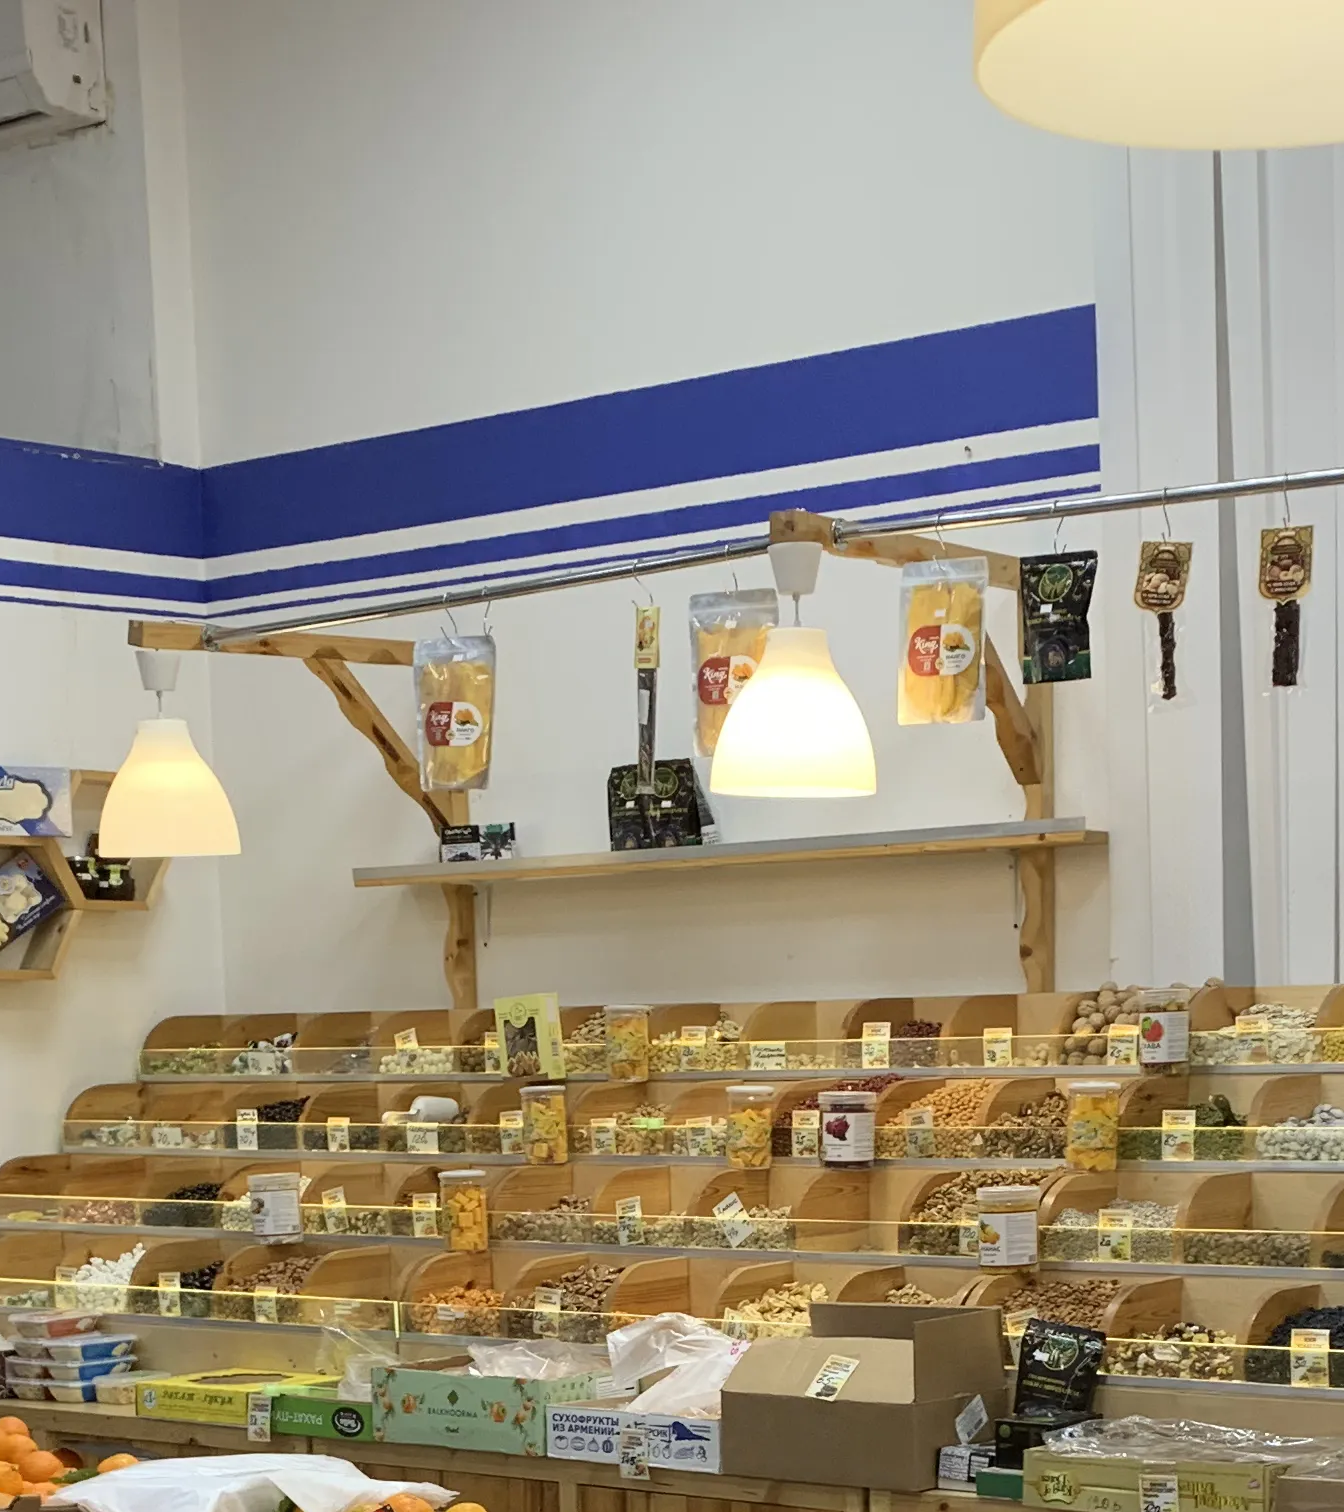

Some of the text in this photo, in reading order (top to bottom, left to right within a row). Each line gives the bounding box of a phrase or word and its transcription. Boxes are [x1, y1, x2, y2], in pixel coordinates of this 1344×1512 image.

[274, 1410, 323, 1425] РАХАТ-ЛУ
[552, 1413, 620, 1427] СУХОФРУКТЫ
[552, 1423, 616, 1436] ИЗ АРМЕНИИ
